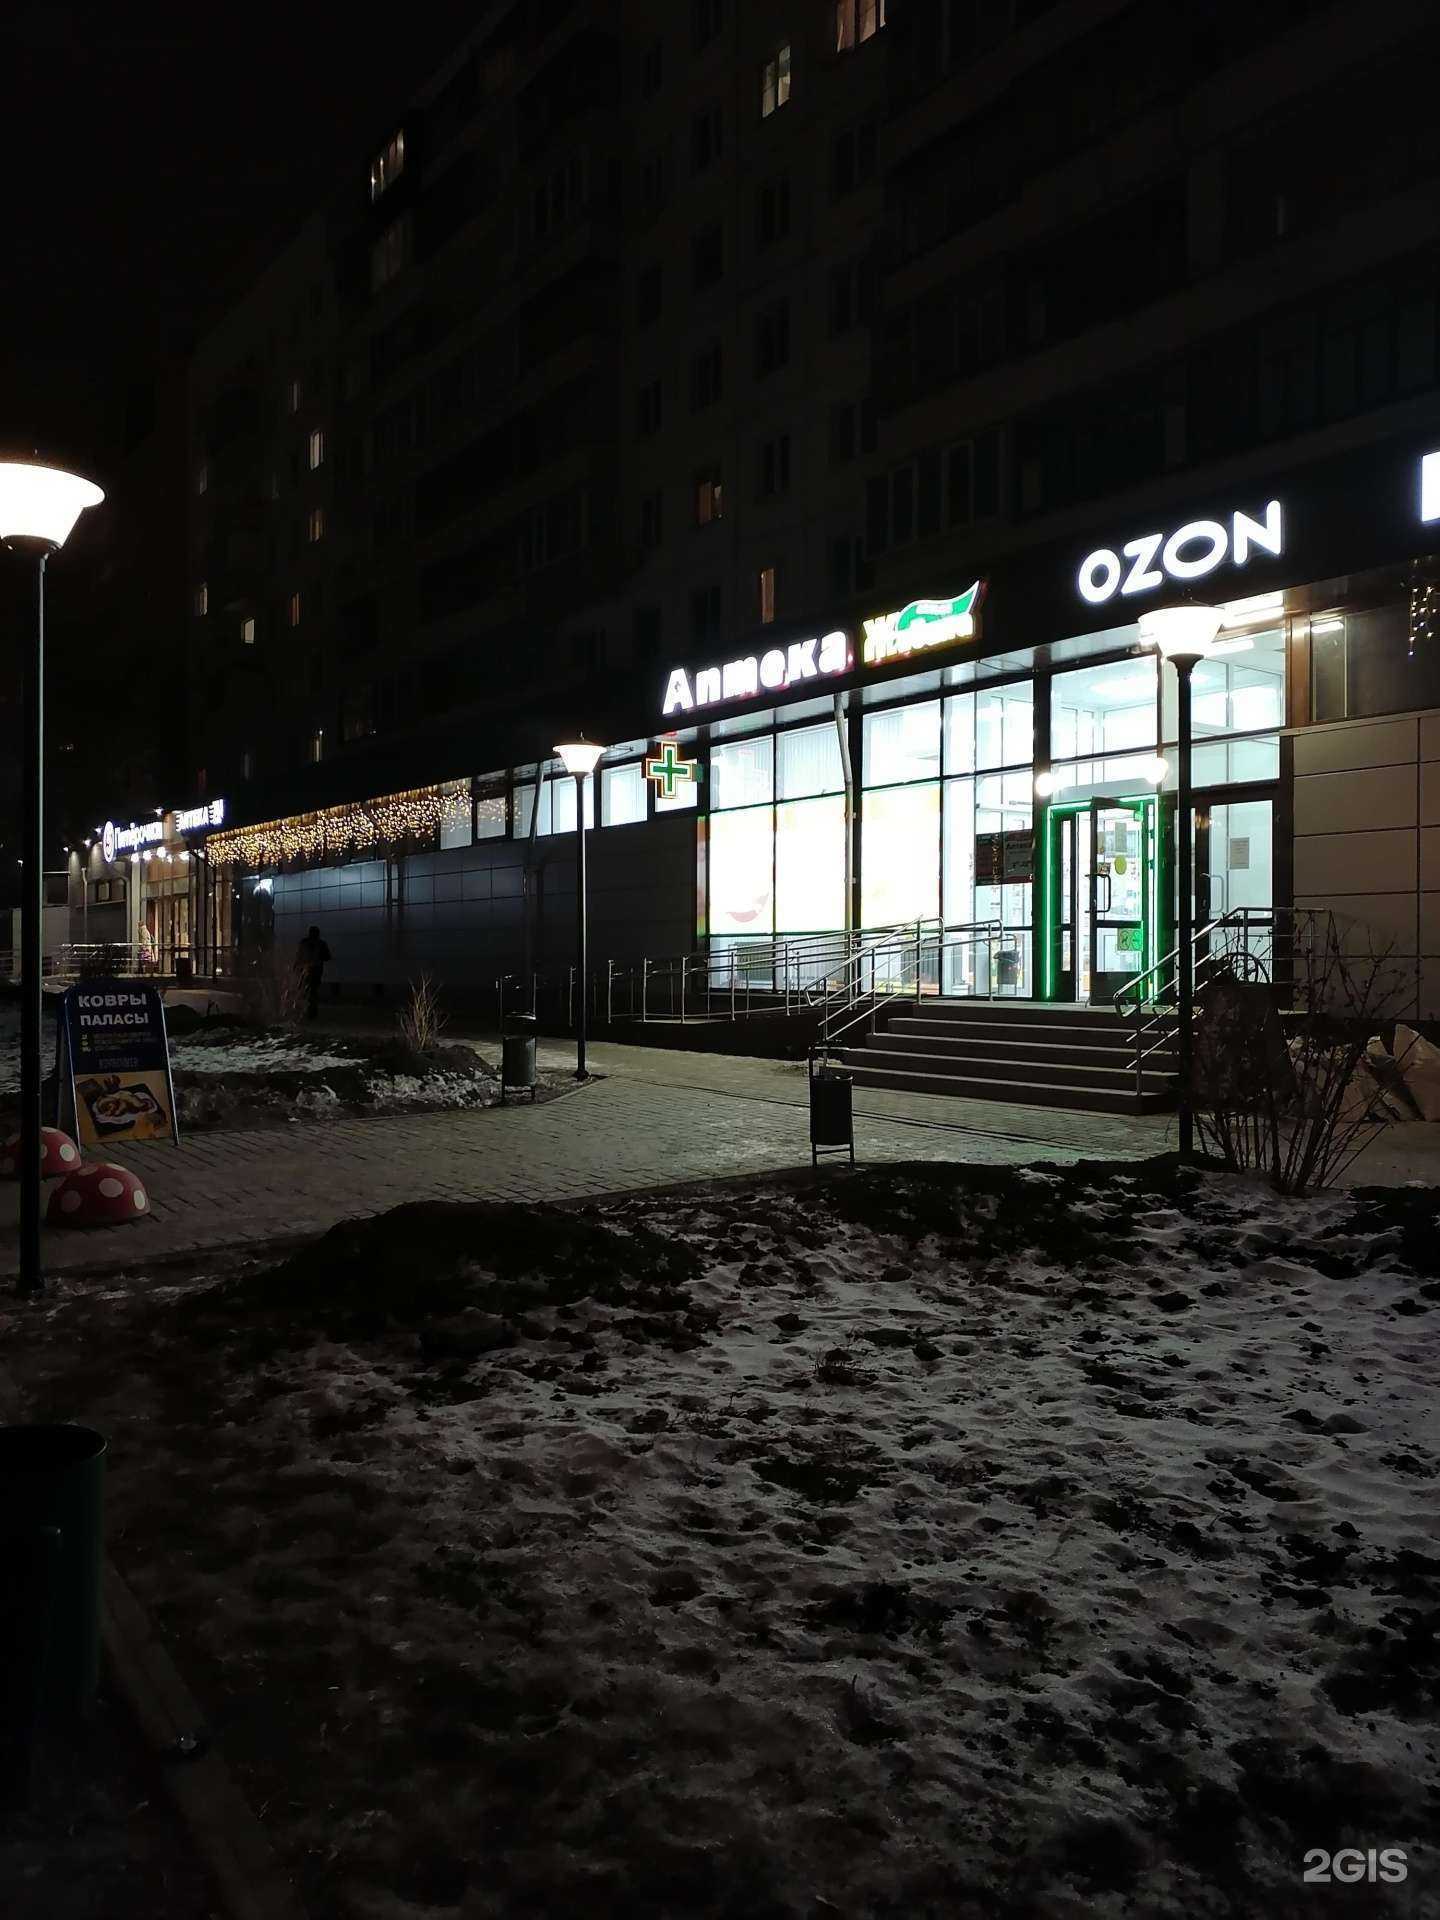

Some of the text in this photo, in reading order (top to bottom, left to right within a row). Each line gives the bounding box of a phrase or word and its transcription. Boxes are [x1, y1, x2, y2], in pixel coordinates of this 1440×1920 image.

[1078, 500, 1281, 602] OZON
[662, 630, 847, 714] Аптека
[78, 993, 147, 1008] КОВРЫ
[80, 1013, 149, 1026] ПАЛАСЫ
